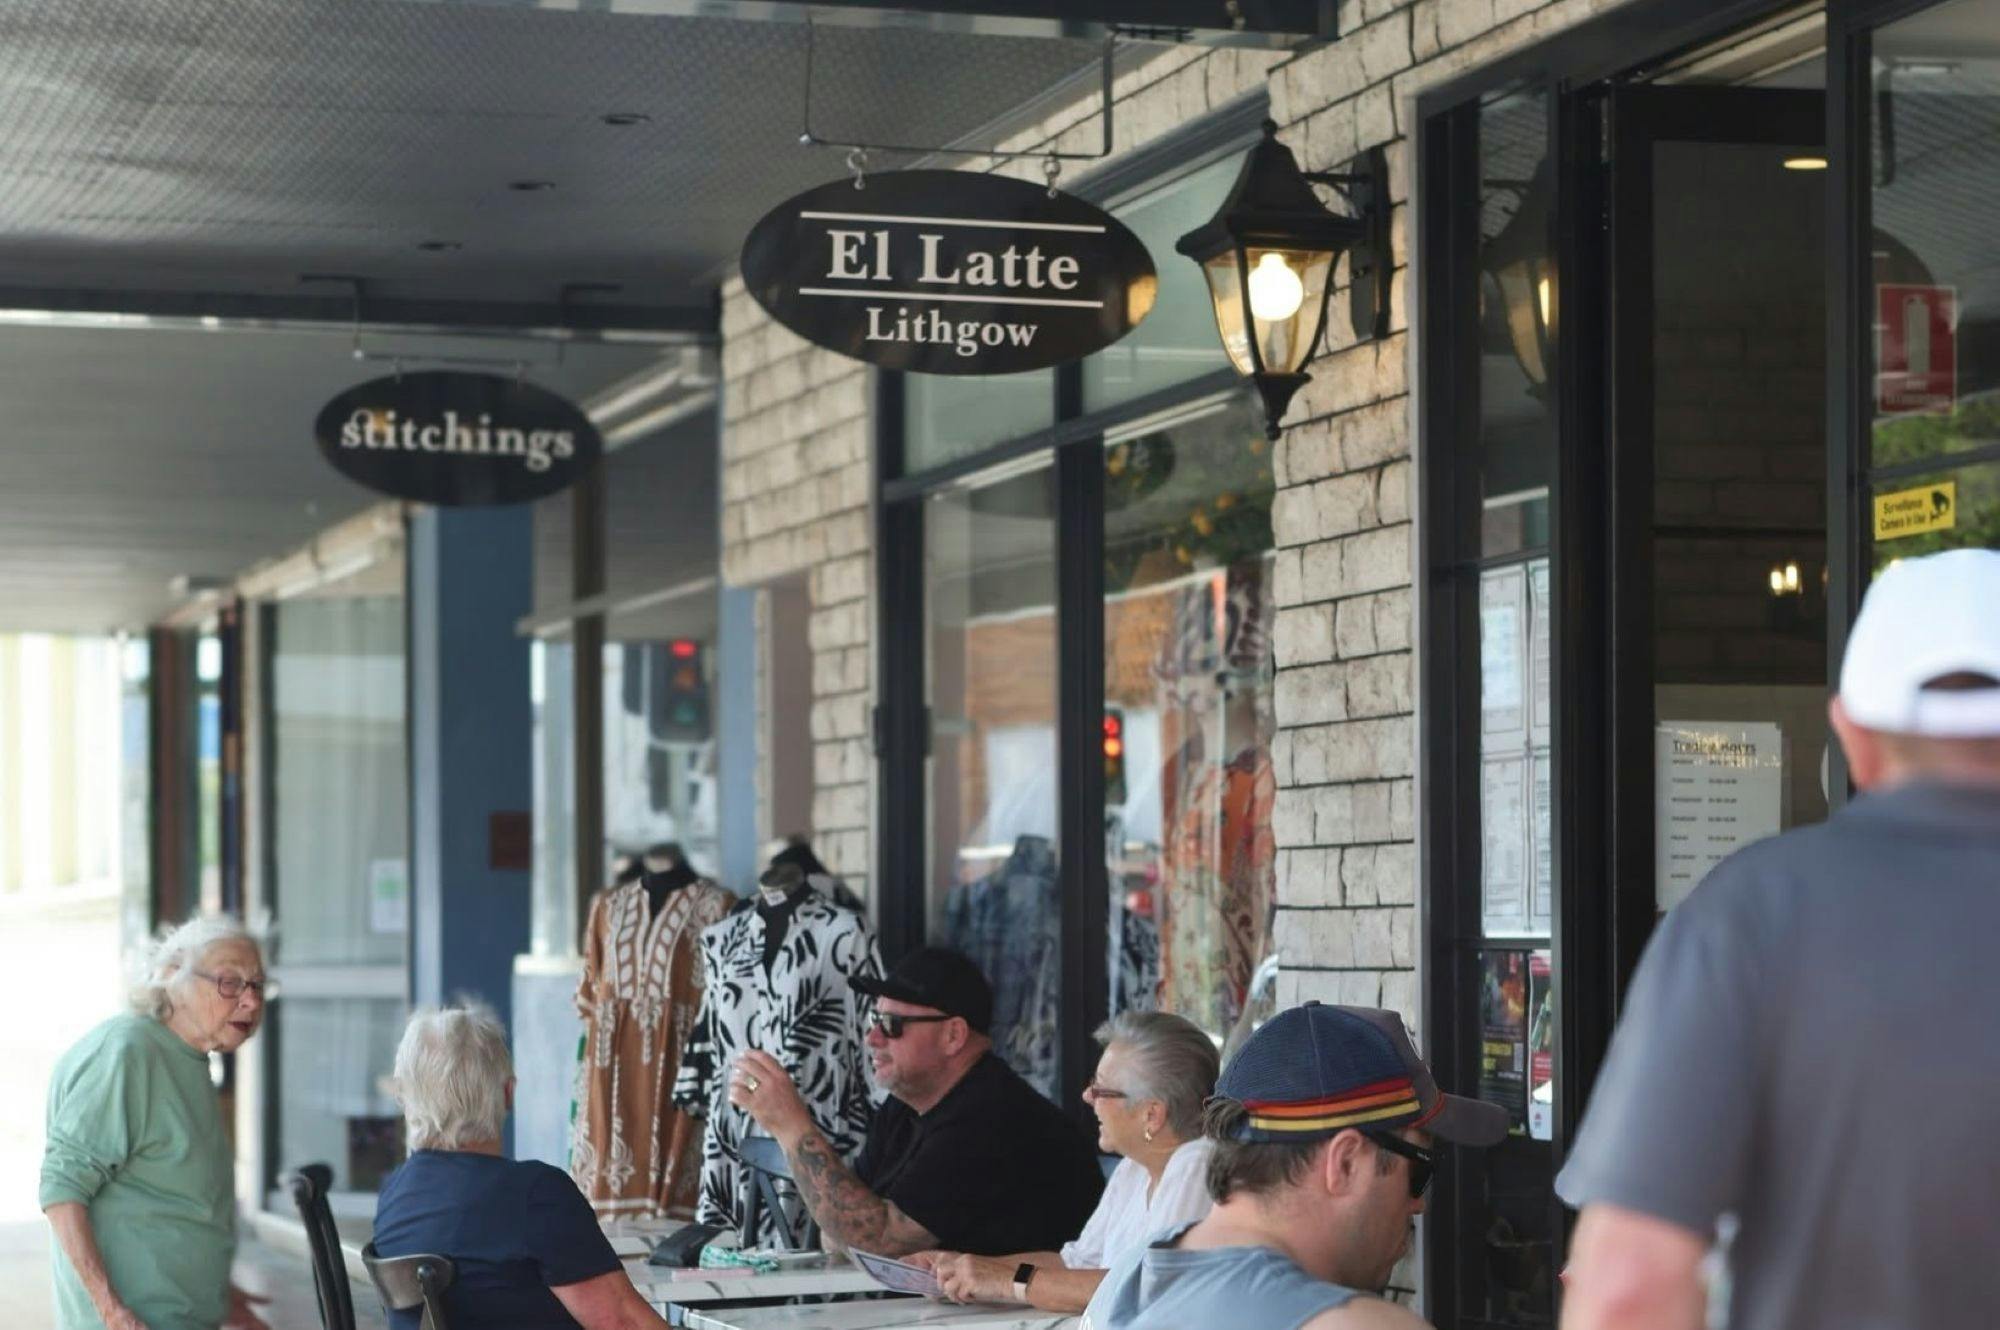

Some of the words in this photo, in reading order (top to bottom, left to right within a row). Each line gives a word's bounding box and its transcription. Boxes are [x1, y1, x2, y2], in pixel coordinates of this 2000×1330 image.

[826, 229, 893, 282] El
[917, 233, 1081, 290] Latte
[866, 307, 1038, 357] Lithgow
[341, 409, 575, 472] stitchings
